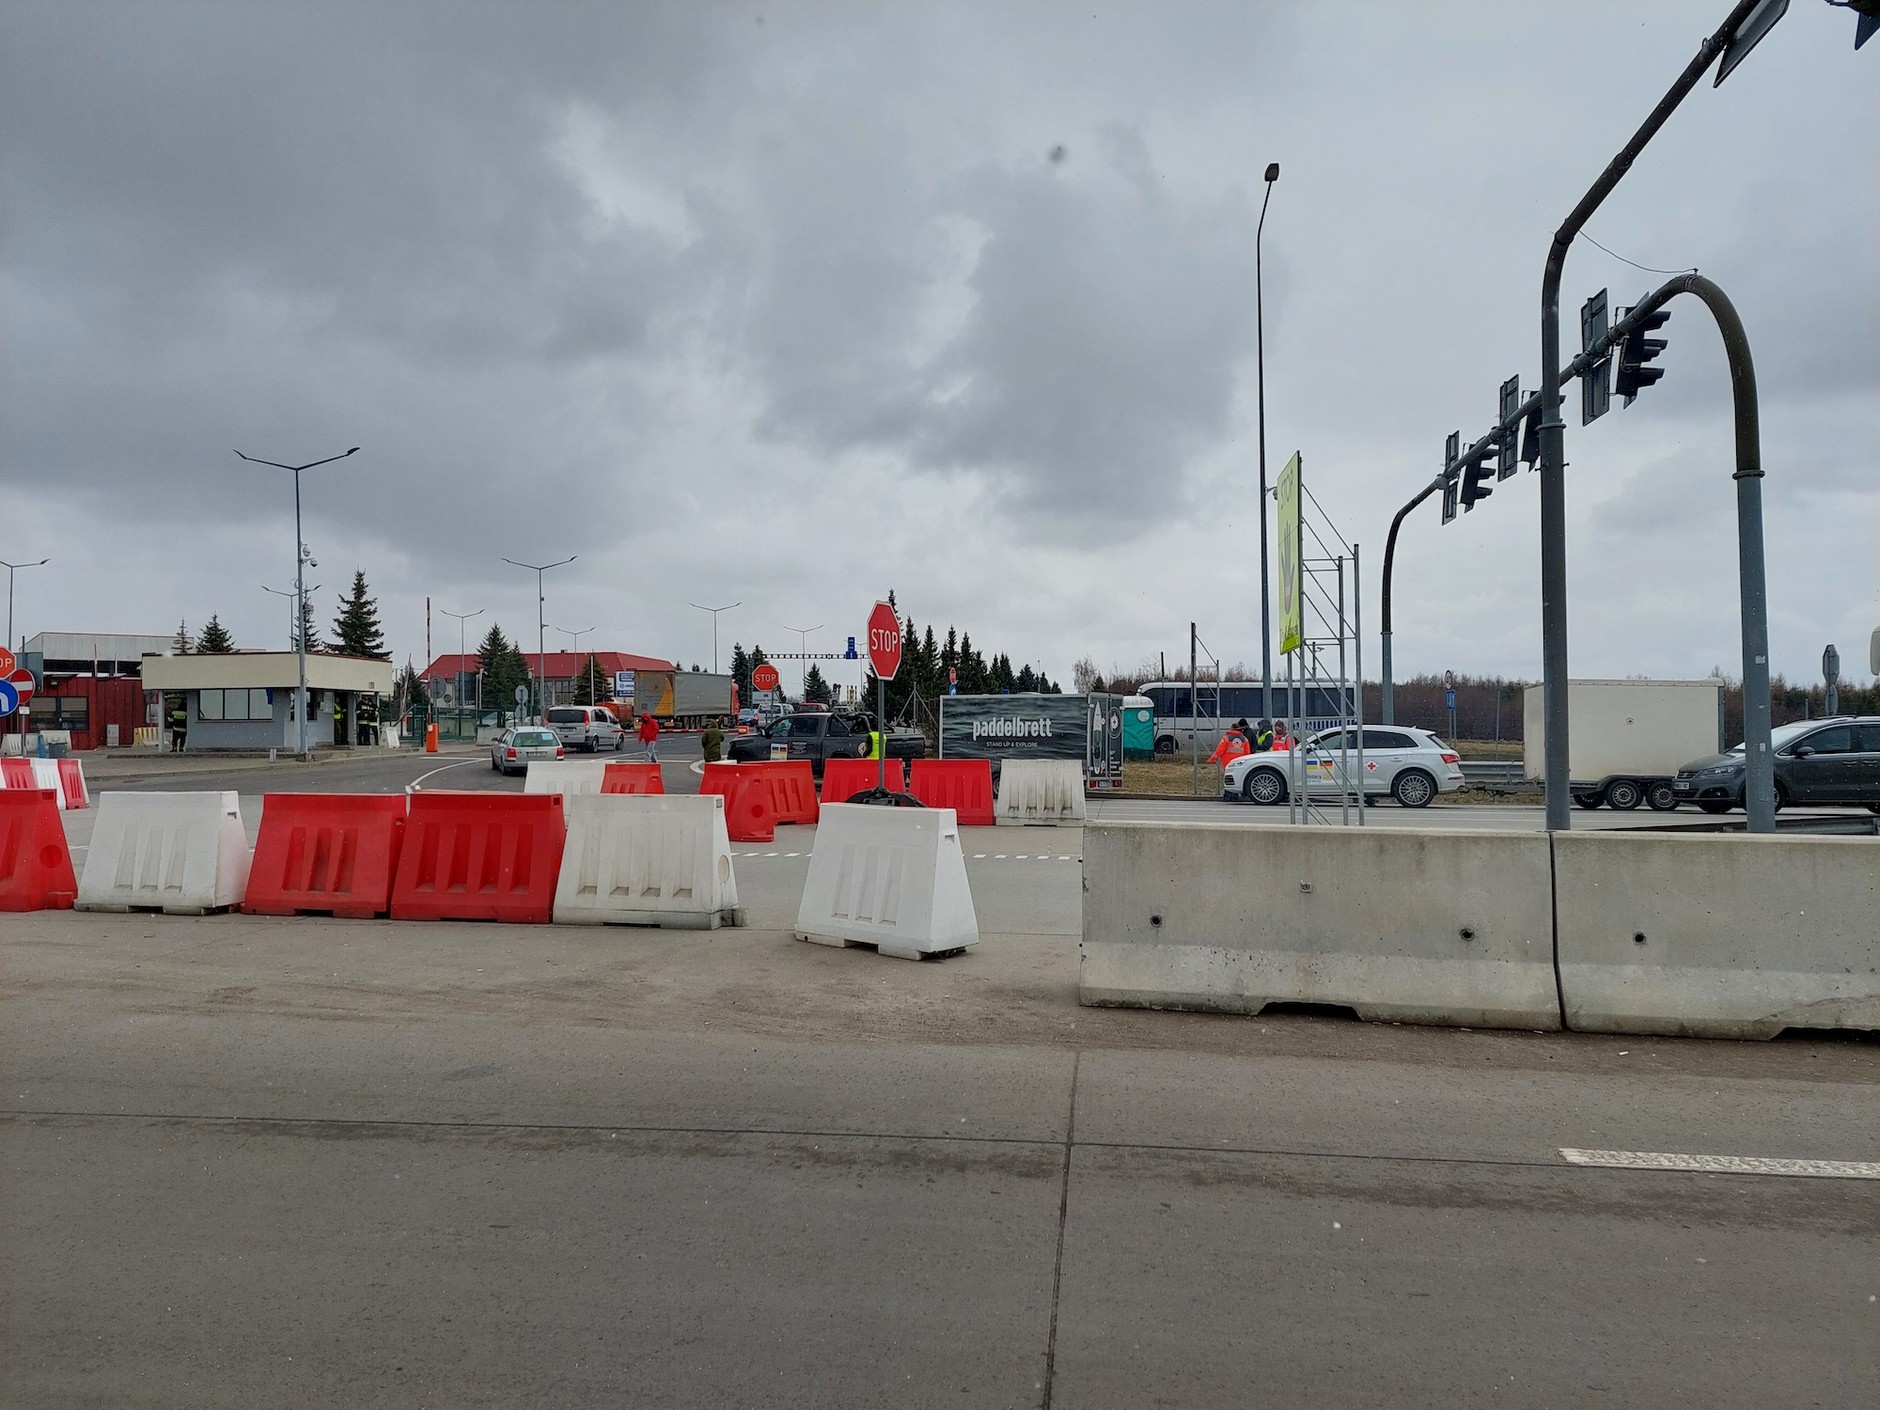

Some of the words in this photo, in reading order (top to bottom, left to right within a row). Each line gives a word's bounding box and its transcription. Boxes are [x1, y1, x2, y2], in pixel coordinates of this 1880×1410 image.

[871, 628, 899, 653] STOP
[755, 673, 777, 683] STOP
[973, 716, 1052, 741] paddelbrett
